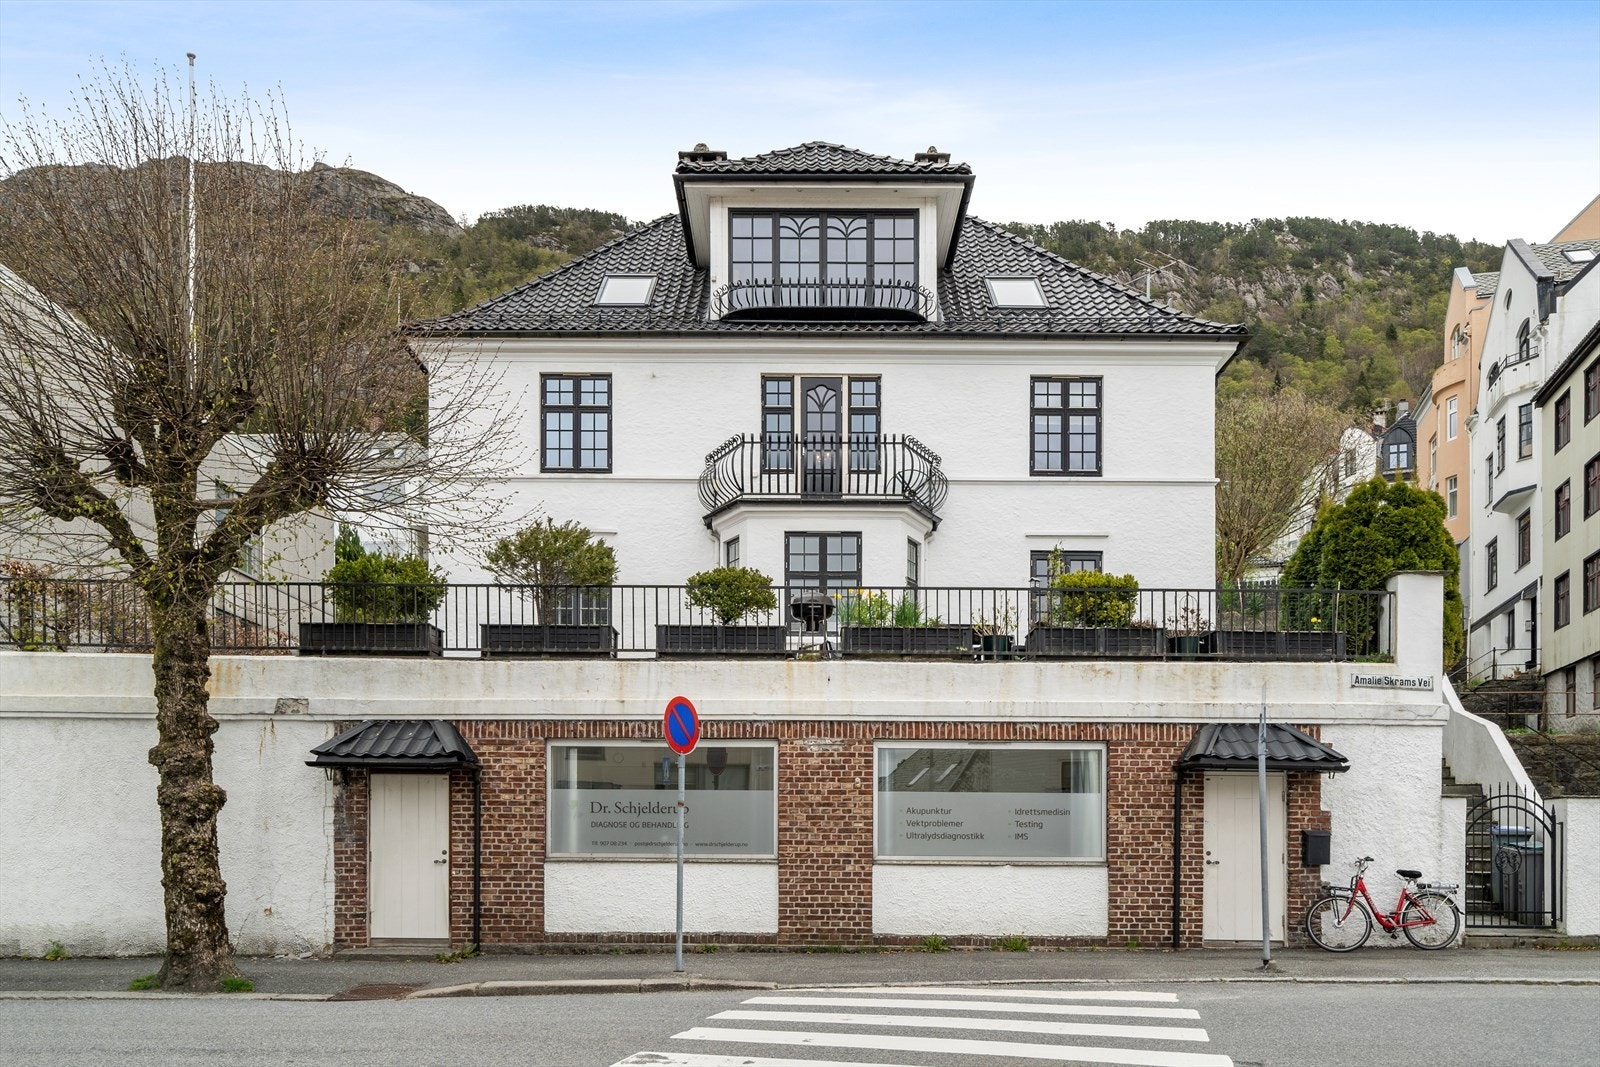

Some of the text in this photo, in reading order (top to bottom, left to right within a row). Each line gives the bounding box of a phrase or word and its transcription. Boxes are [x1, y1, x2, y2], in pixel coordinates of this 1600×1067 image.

[1354, 675, 1431, 687] Amalie Skrams Vei
[590, 801, 611, 814] Dr.
[906, 807, 952, 816] Akupunktur
[1014, 807, 1071, 816] Idrettsmedisin
[590, 821, 627, 829] DIAGNOSE
[629, 821, 640, 829] OG
[906, 819, 964, 829] Vektproblemer
[1014, 820, 1043, 830] Testing
[906, 832, 985, 842] Ultralydsdiagnostikk
[1014, 832, 1029, 841] IMS
